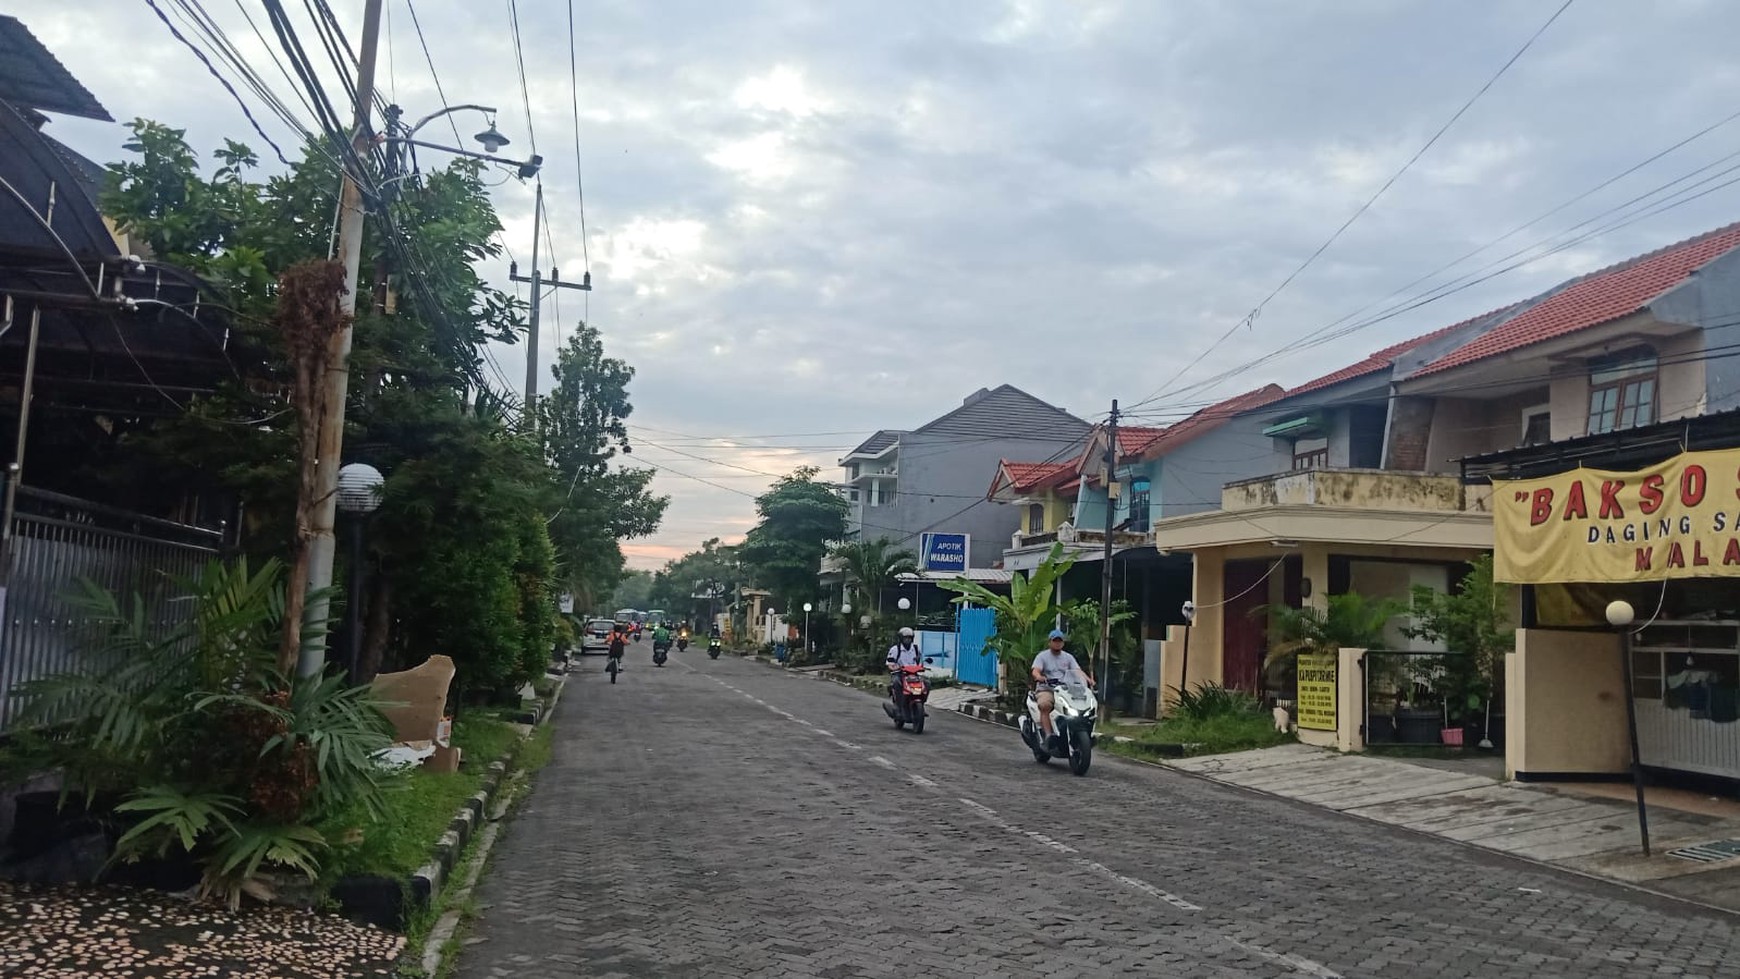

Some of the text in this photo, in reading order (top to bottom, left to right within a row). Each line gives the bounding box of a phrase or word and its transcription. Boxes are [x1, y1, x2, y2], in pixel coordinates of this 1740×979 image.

[1587, 516, 1691, 543] DAGING
[937, 542, 962, 550] APOTIK
[930, 553, 963, 563] WARASHO
